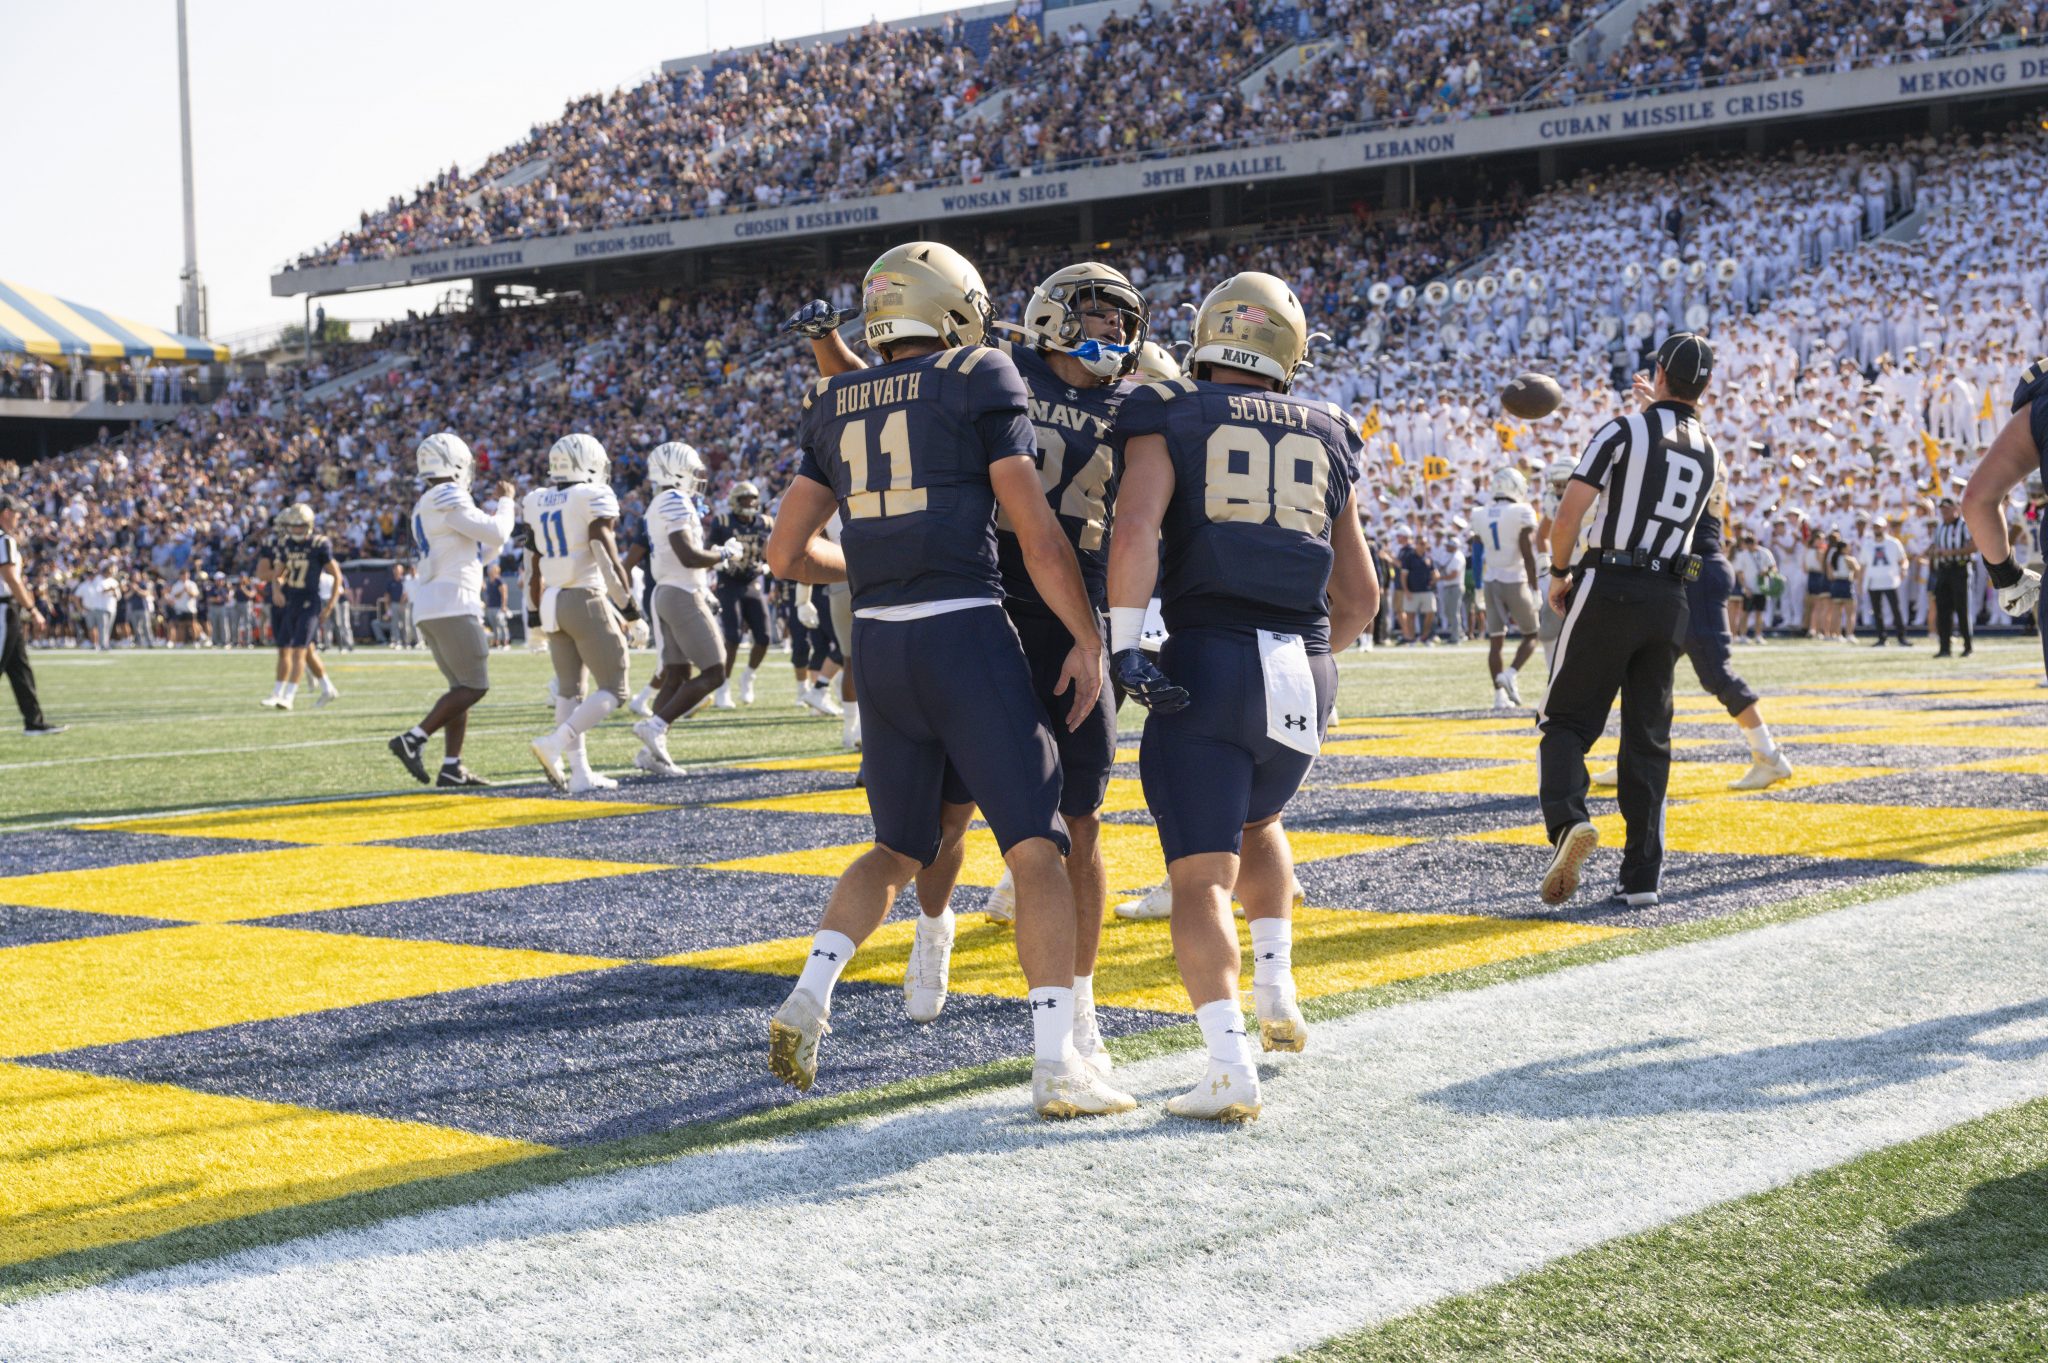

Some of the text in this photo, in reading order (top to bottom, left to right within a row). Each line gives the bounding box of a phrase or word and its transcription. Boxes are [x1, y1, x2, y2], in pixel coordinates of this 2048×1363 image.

[1899, 63, 2006, 94] MEKONG
[1540, 89, 1804, 138] CUBAN MISSILE CRISIS
[1364, 134, 1455, 161] LEBANON
[1142, 156, 1286, 187] 38TH PARALLEL
[942, 182, 1069, 212] WONSAN SIEGE
[734, 206, 880, 237] CHOSIN RESERVOIR
[575, 232, 675, 257] INCHON-SEOUL
[411, 251, 523, 277] PUSAN PERIMETER
[868, 322, 894, 339] NAVY
[1221, 348, 1260, 367] NAVY
[836, 372, 922, 416] HORVATH
[1027, 400, 1113, 440] NAVY
[1228, 395, 1309, 430] SCULLY
[839, 409, 928, 520] 11
[1205, 424, 1330, 538] 88
[1654, 448, 1704, 523] B
[540, 509, 569, 558] 11
[1489, 521, 1500, 551] 1
[1651, 559, 1660, 571] S
